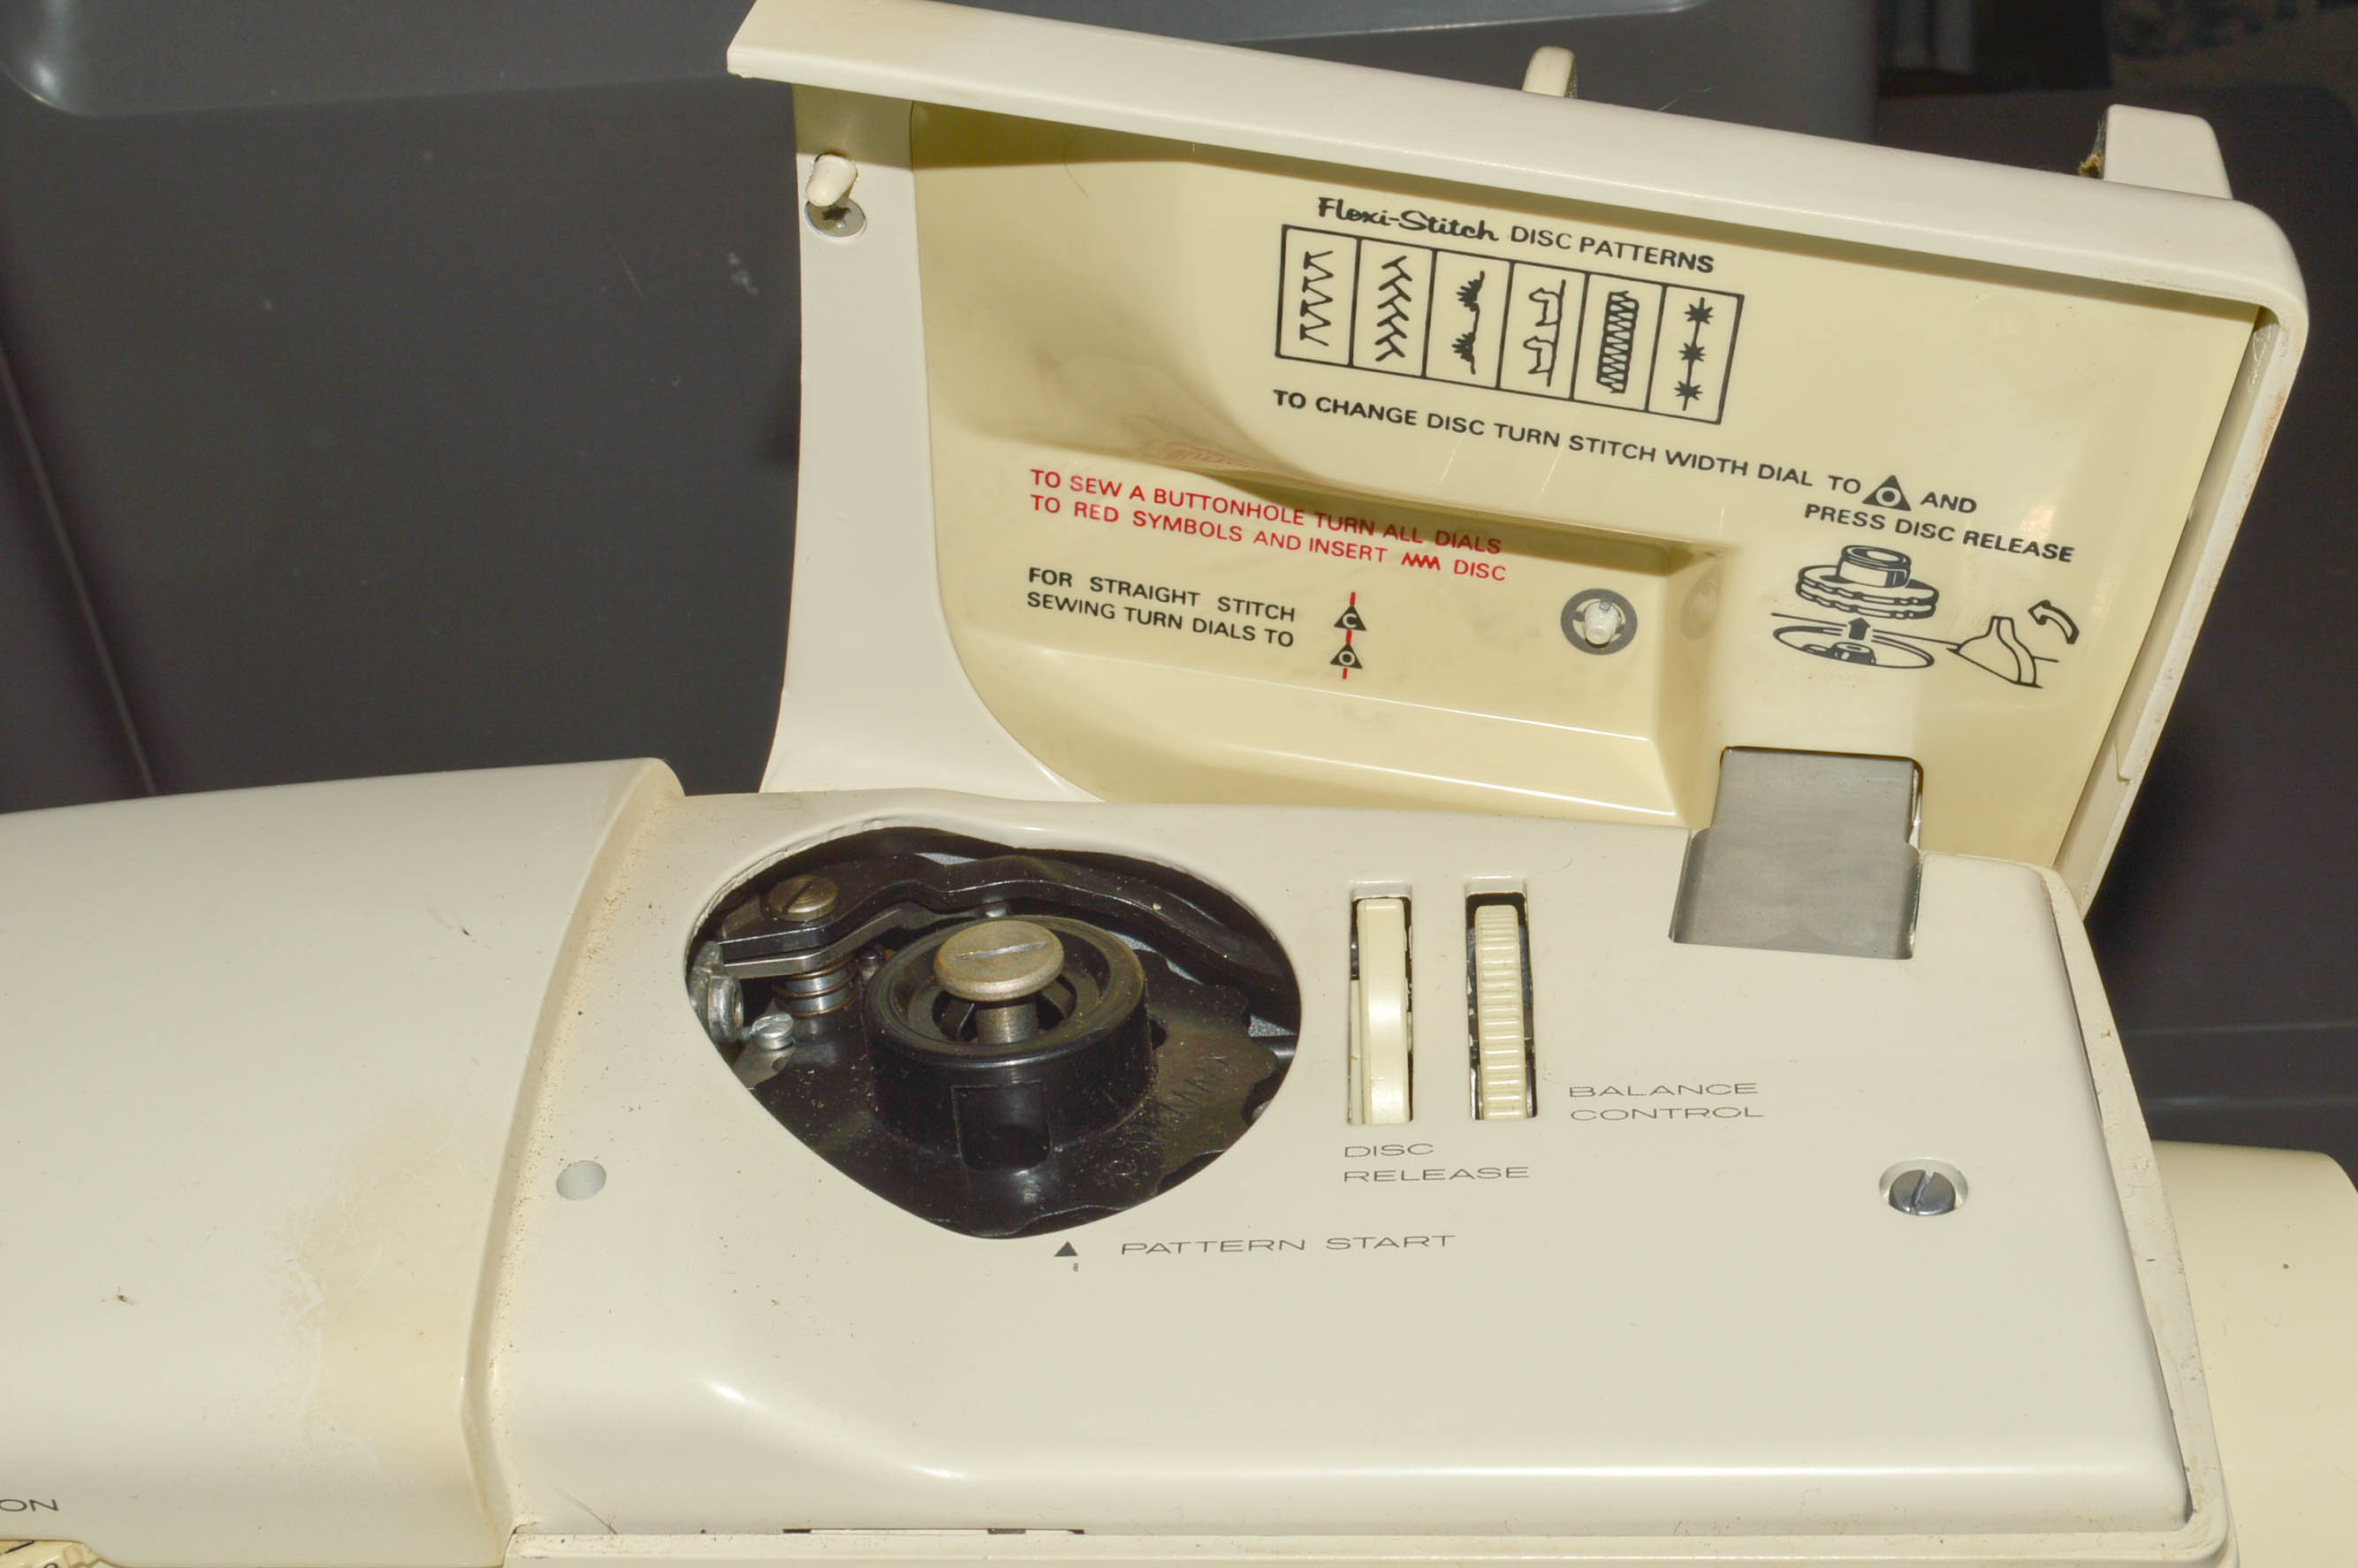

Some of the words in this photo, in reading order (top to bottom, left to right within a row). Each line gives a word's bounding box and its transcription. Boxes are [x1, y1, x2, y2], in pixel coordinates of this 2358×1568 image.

[1319, 197, 1499, 241] Flexi-Stitch
[1510, 226, 1571, 249] DISC
[1579, 237, 1714, 273] PATTERNS
[1273, 390, 1306, 409] TO
[1315, 397, 1417, 425] CHANGE
[1427, 413, 1485, 435] DISC
[1494, 423, 1560, 447] TURN
[1569, 435, 1656, 462] STITCH
[1665, 450, 1748, 476] WIDTH
[1758, 464, 1813, 486] DIAL
[1828, 476, 1860, 494] TO
[1921, 491, 1977, 514] AND
[1031, 468, 1061, 488] TO
[1070, 476, 1122, 497] SEW
[1130, 485, 1145, 501] A
[1153, 488, 1305, 525] BUTTONHOLE
[1315, 512, 1374, 535] TURN
[1383, 523, 1423, 544] ALL
[1435, 530, 1500, 553] DIALS
[1031, 494, 1061, 514] TO
[1075, 501, 1119, 522] RED
[1133, 510, 1242, 542] SYMBOLS
[1253, 530, 1301, 550] AND
[1310, 537, 1388, 562] INSERT
[1454, 559, 1506, 581] DISC
[1805, 504, 1885, 529] PRESS
[1895, 519, 1955, 542] DISC
[1963, 530, 2074, 562] RELEASE
[1028, 591, 1114, 619] SEWING
[1124, 607, 1183, 629] TURN
[1192, 618, 1255, 641] DIALS
[1265, 628, 1294, 647] TO
[1029, 567, 1072, 587] FOR
[1090, 576, 1200, 606] STRAIGHT
[1218, 597, 1295, 622] STITCH
[1570, 1084, 1760, 1098] BALANCE
[1571, 1107, 1762, 1120] CONTROL
[1344, 1167, 1531, 1183] RELEASE
[1345, 1144, 1433, 1157] DISC
[1122, 1240, 1305, 1254] PATTERN
[1327, 1236, 1454, 1250] START
